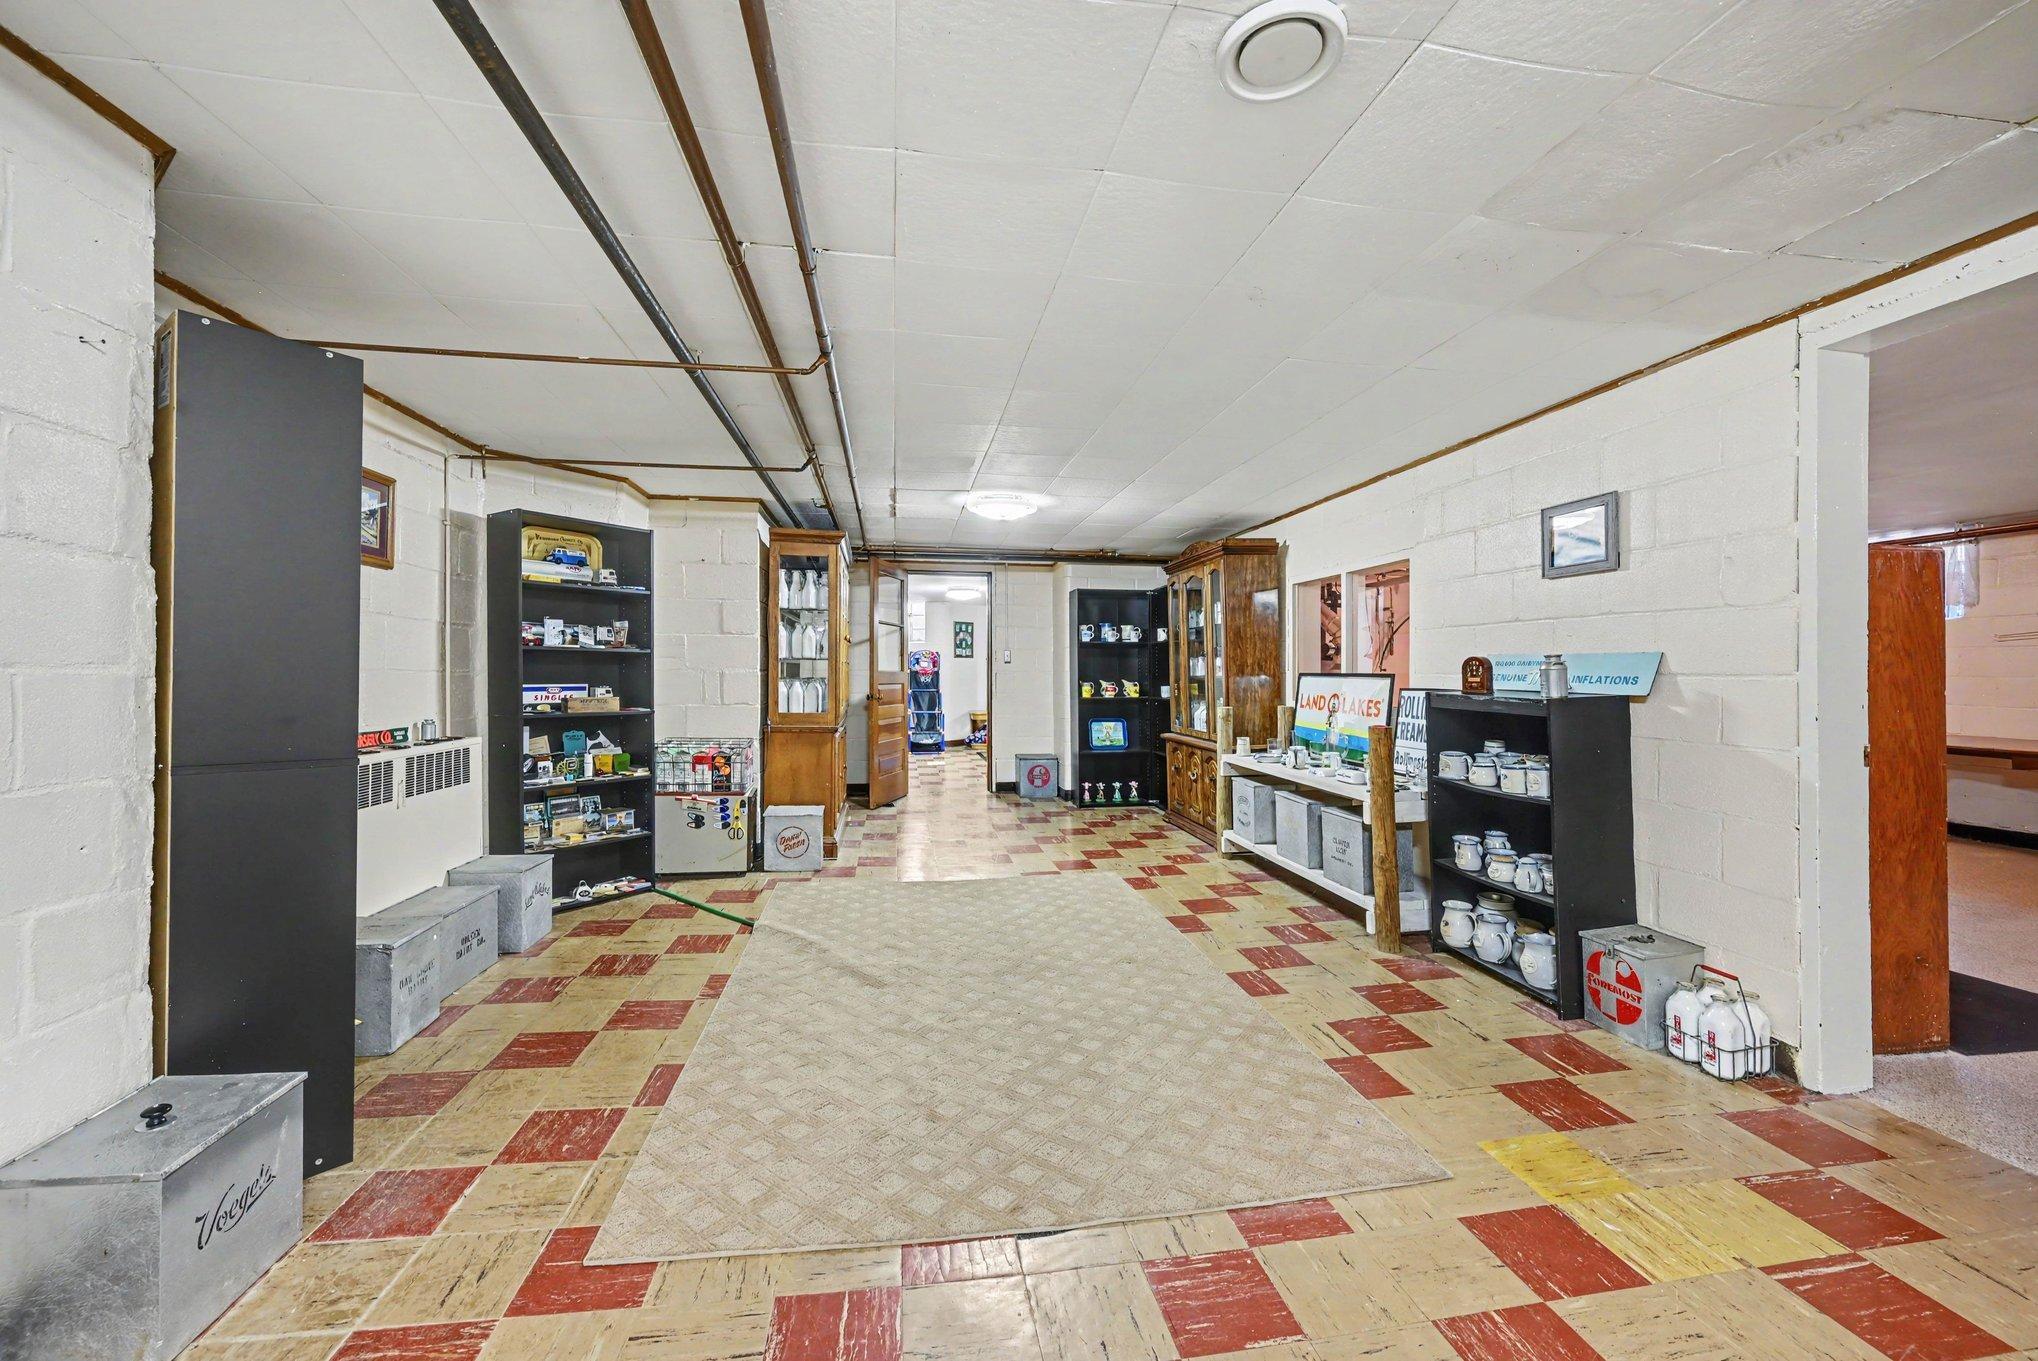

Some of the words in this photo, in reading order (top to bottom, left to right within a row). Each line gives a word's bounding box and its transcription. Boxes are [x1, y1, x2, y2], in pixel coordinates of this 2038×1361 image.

[1493, 673, 1527, 682] ENUINE
[1571, 674, 1639, 686] INFLATIONS
[1300, 693, 1325, 711] LAND
[1342, 696, 1382, 718] LAKES
[1400, 694, 1427, 720] ROLLI
[1586, 972, 1643, 1005] FOREMOST
